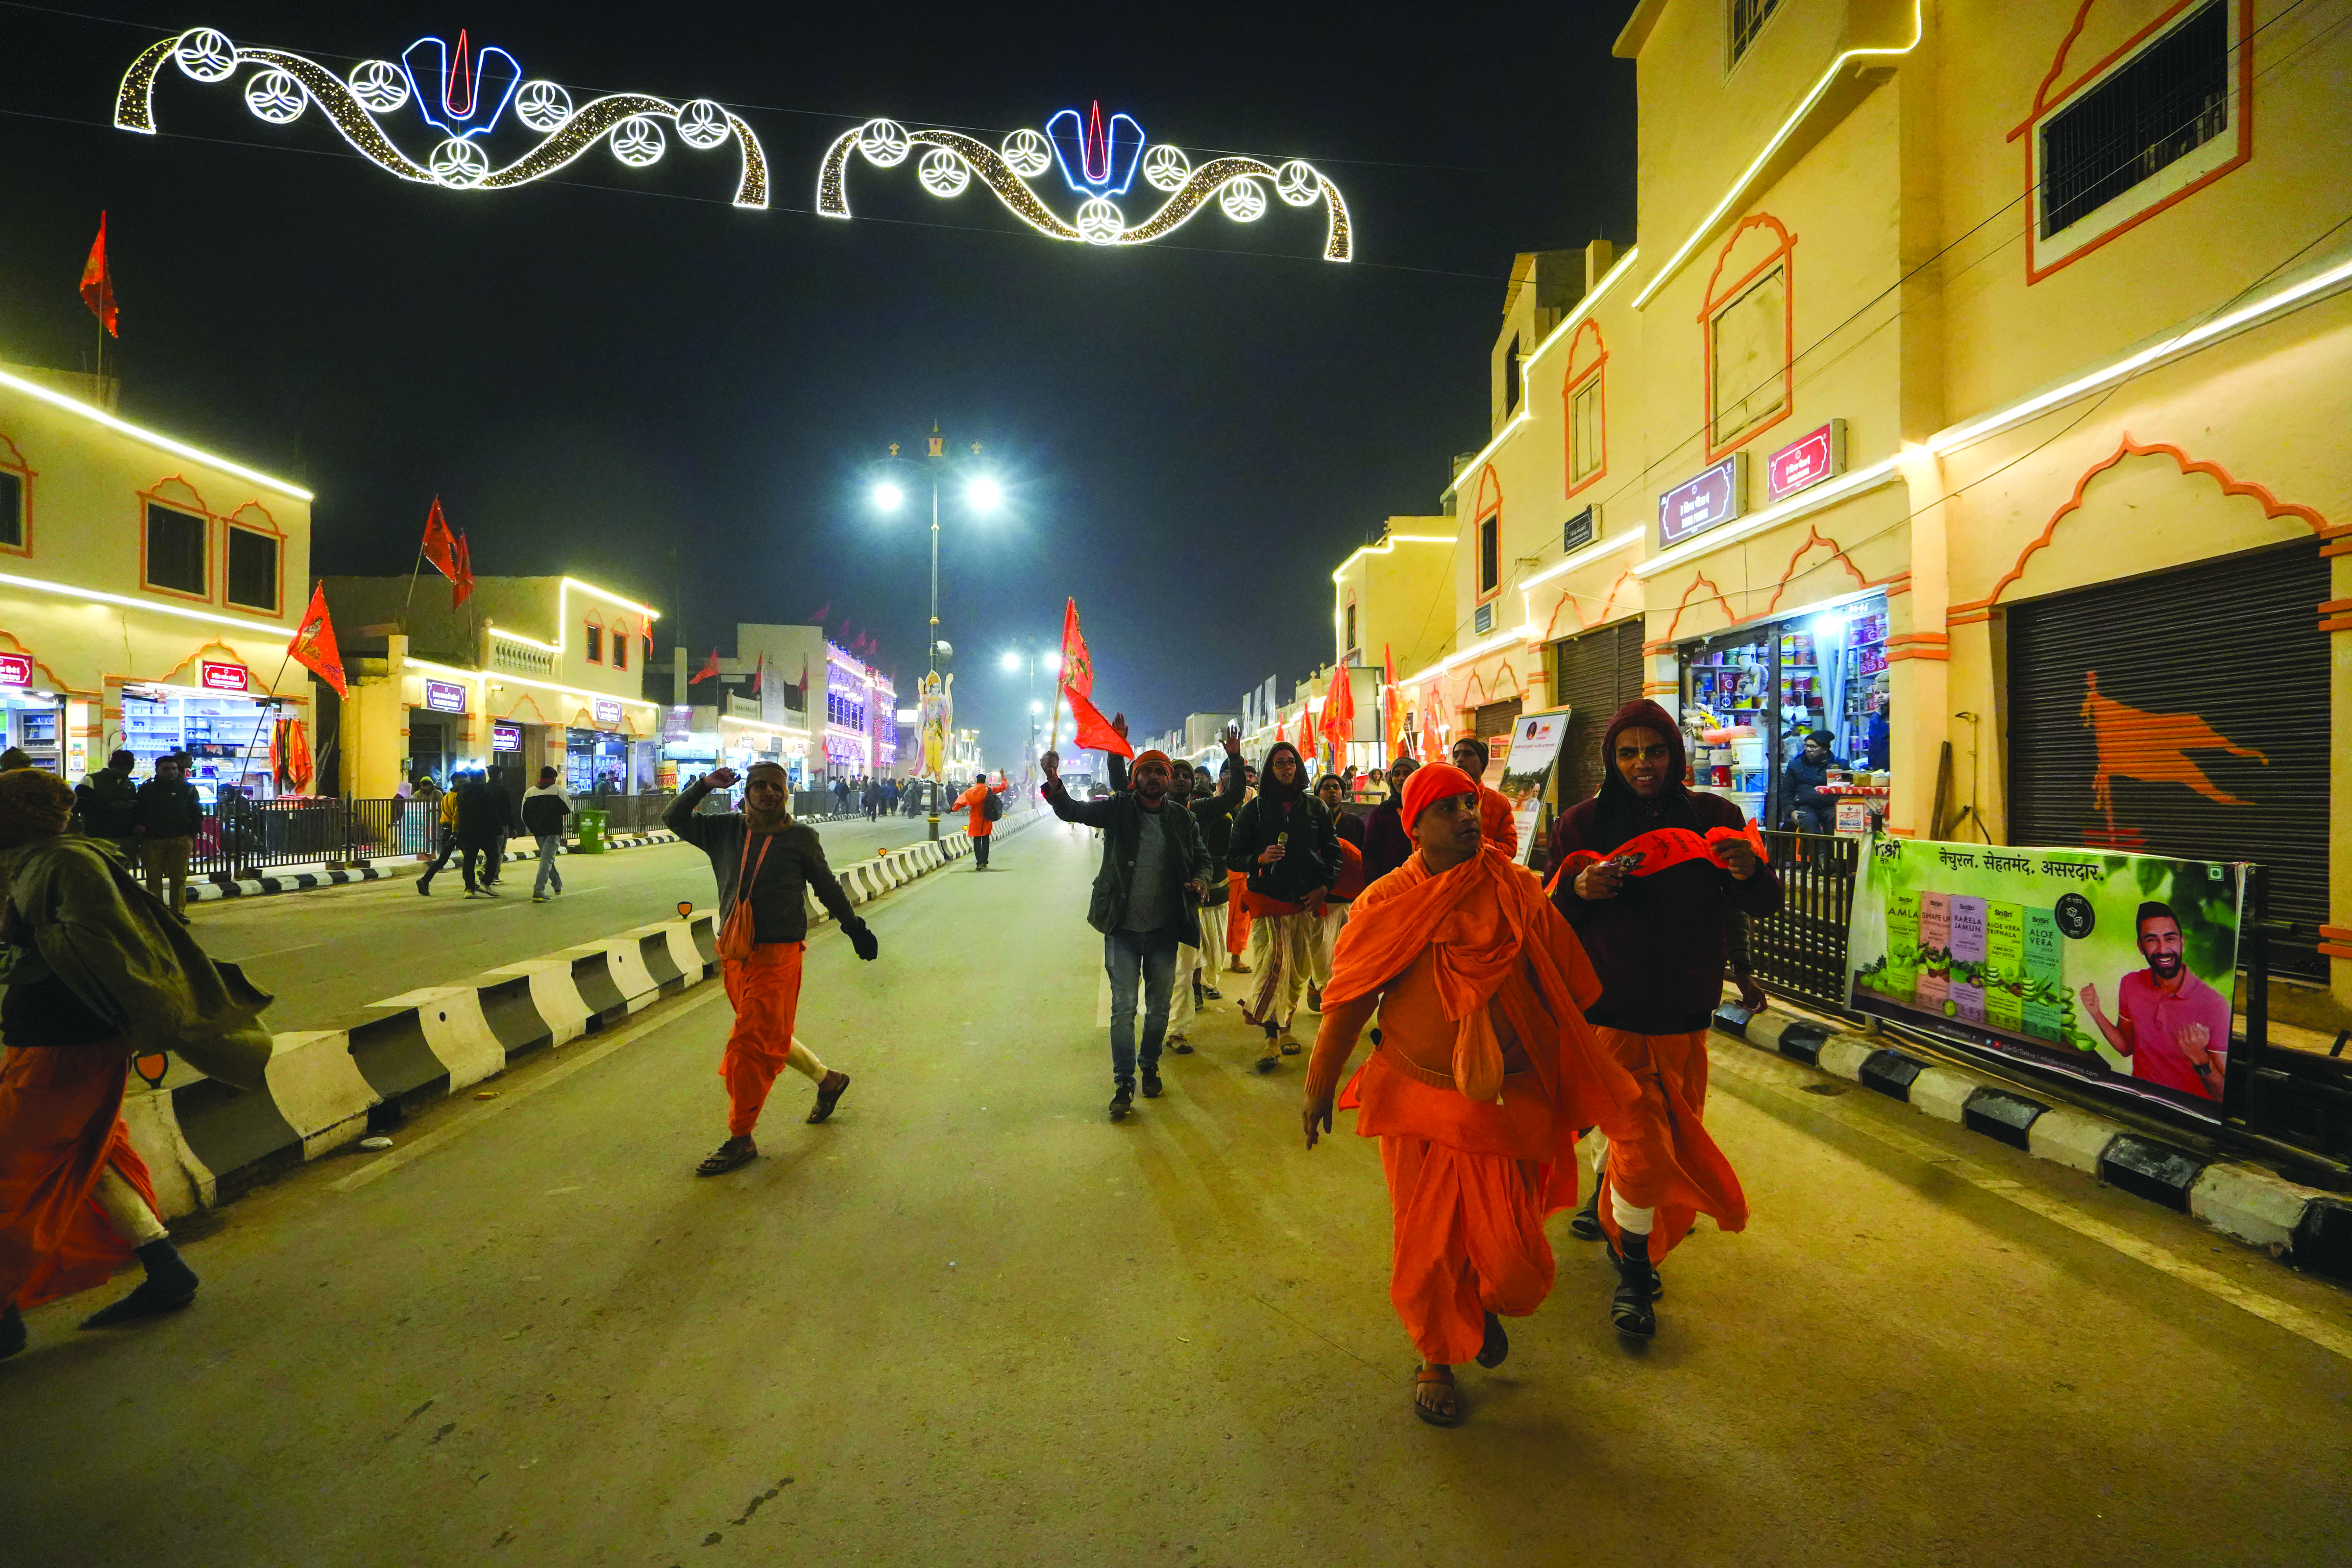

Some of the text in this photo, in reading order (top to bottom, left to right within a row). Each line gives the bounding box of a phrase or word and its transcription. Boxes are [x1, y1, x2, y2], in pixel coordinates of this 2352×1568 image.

[1939, 847, 2105, 882] नेचुरल. सेहतमंद. असरदार.
[1887, 907, 1919, 920] AMLA
[1922, 911, 1941, 922] SHAPE
[1954, 914, 1982, 926] KARELA
[1954, 922, 1981, 932] JAMUN
[1986, 928, 2017, 938] TRIPHALA
[2029, 929, 2054, 939] ALOE
[2029, 936, 2053, 948] VERA
